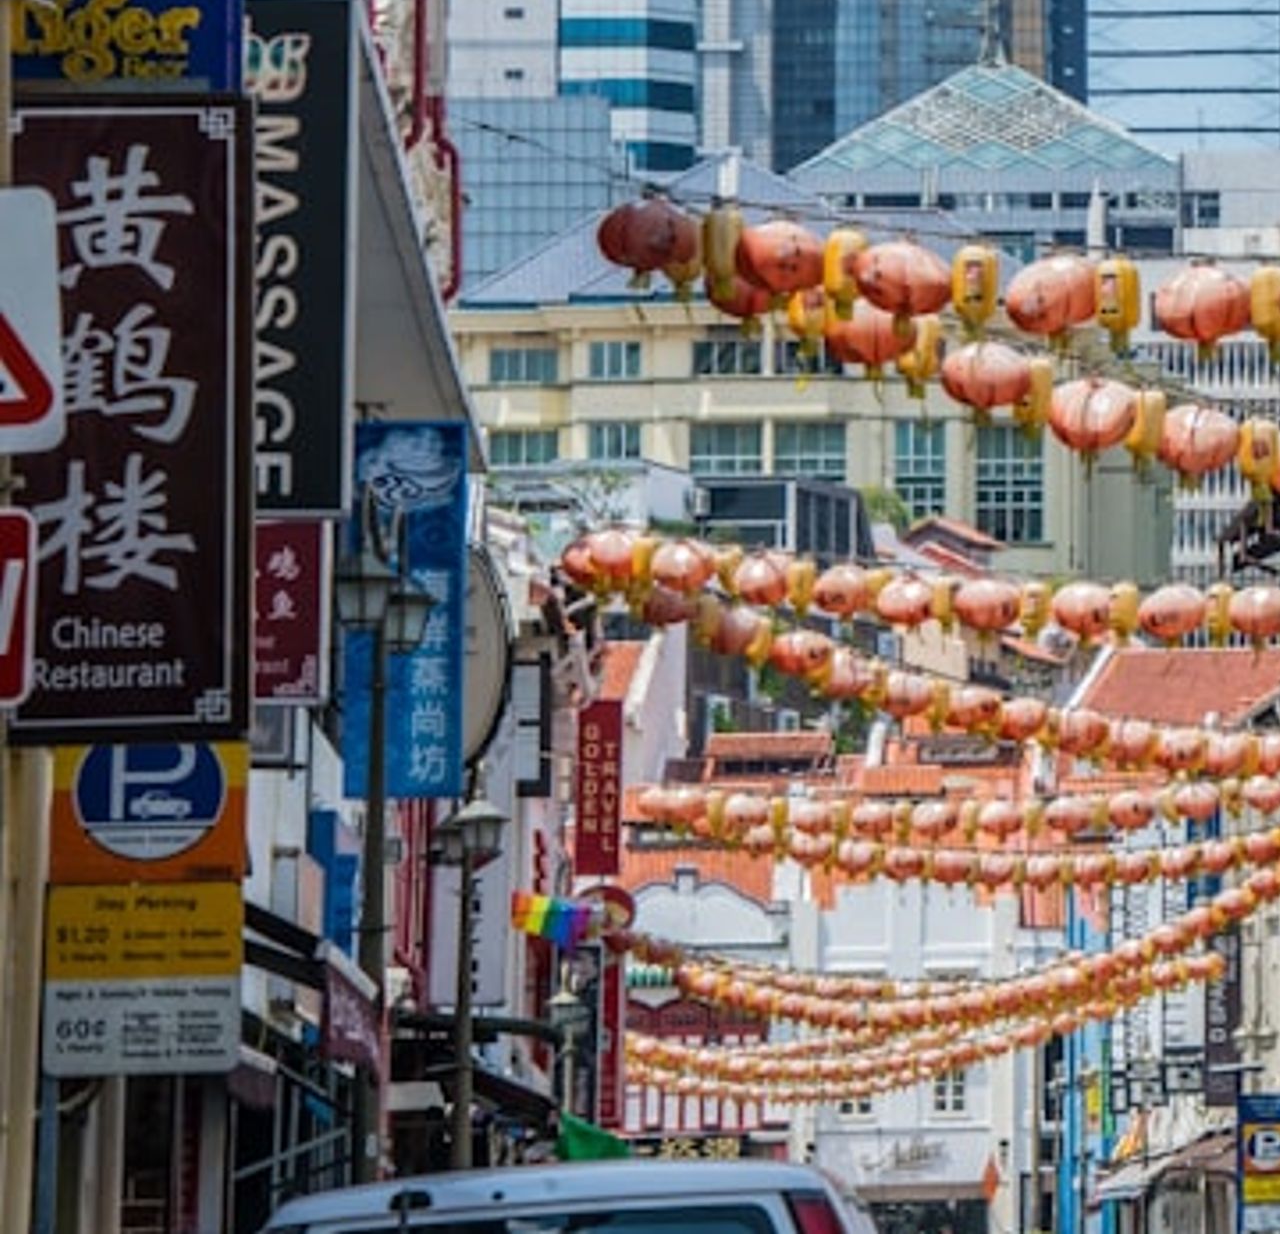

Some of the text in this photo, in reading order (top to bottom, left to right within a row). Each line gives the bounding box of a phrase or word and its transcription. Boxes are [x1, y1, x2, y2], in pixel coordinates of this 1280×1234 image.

[253, 115, 301, 497] MASSAGE
[33, 658, 185, 689] Restaurant
[52, 618, 165, 649] Chinese
[582, 723, 600, 834] GOLDEN
[601, 742, 618, 852] TRAVEL
